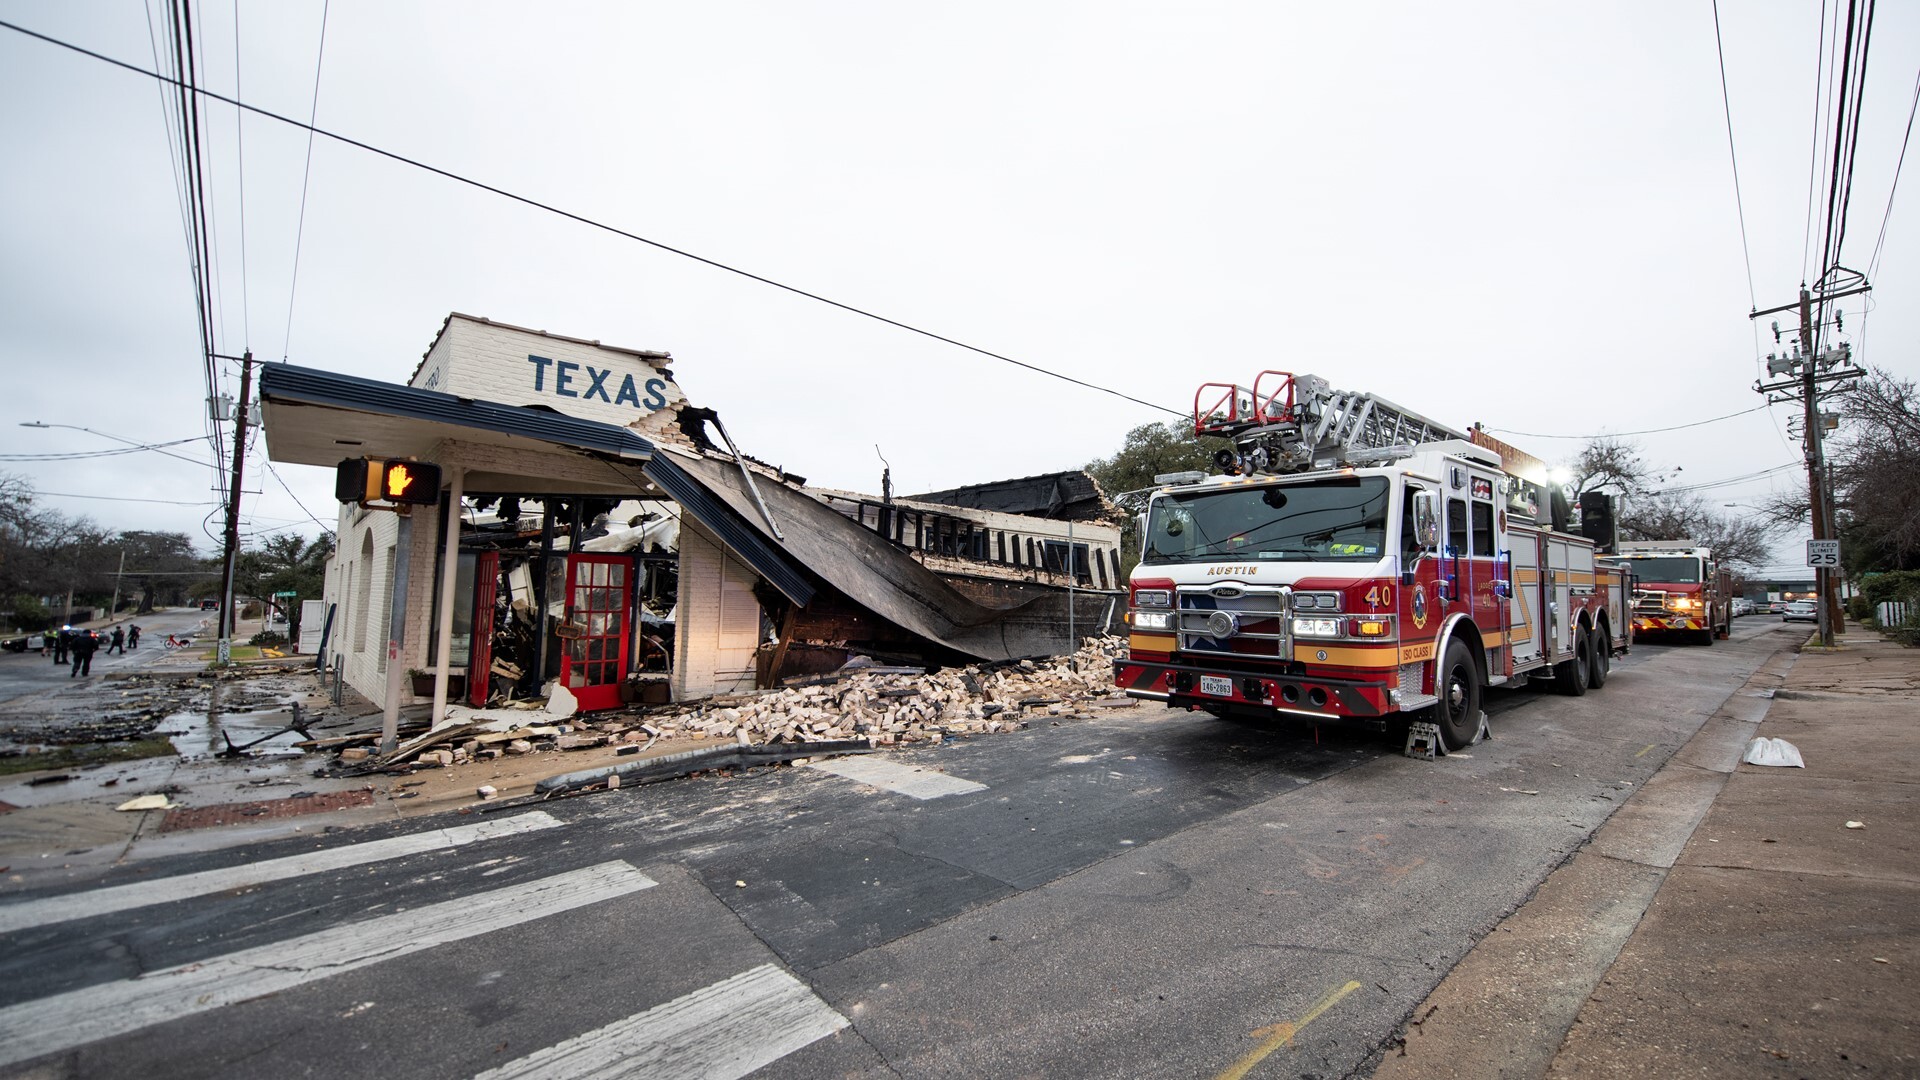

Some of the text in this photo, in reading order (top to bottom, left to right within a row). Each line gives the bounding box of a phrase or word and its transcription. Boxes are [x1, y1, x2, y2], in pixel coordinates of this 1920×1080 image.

[528, 354, 667, 411] TEXAS
[1810, 554, 1837, 564] 25
[1207, 566, 1258, 576] AUSTIN
[1215, 588, 1237, 596] Pierce
[1364, 585, 1391, 607] 40
[1482, 593, 1491, 608] 40
[1403, 648, 1413, 660] ISO
[1413, 646, 1429, 658] CLASS
